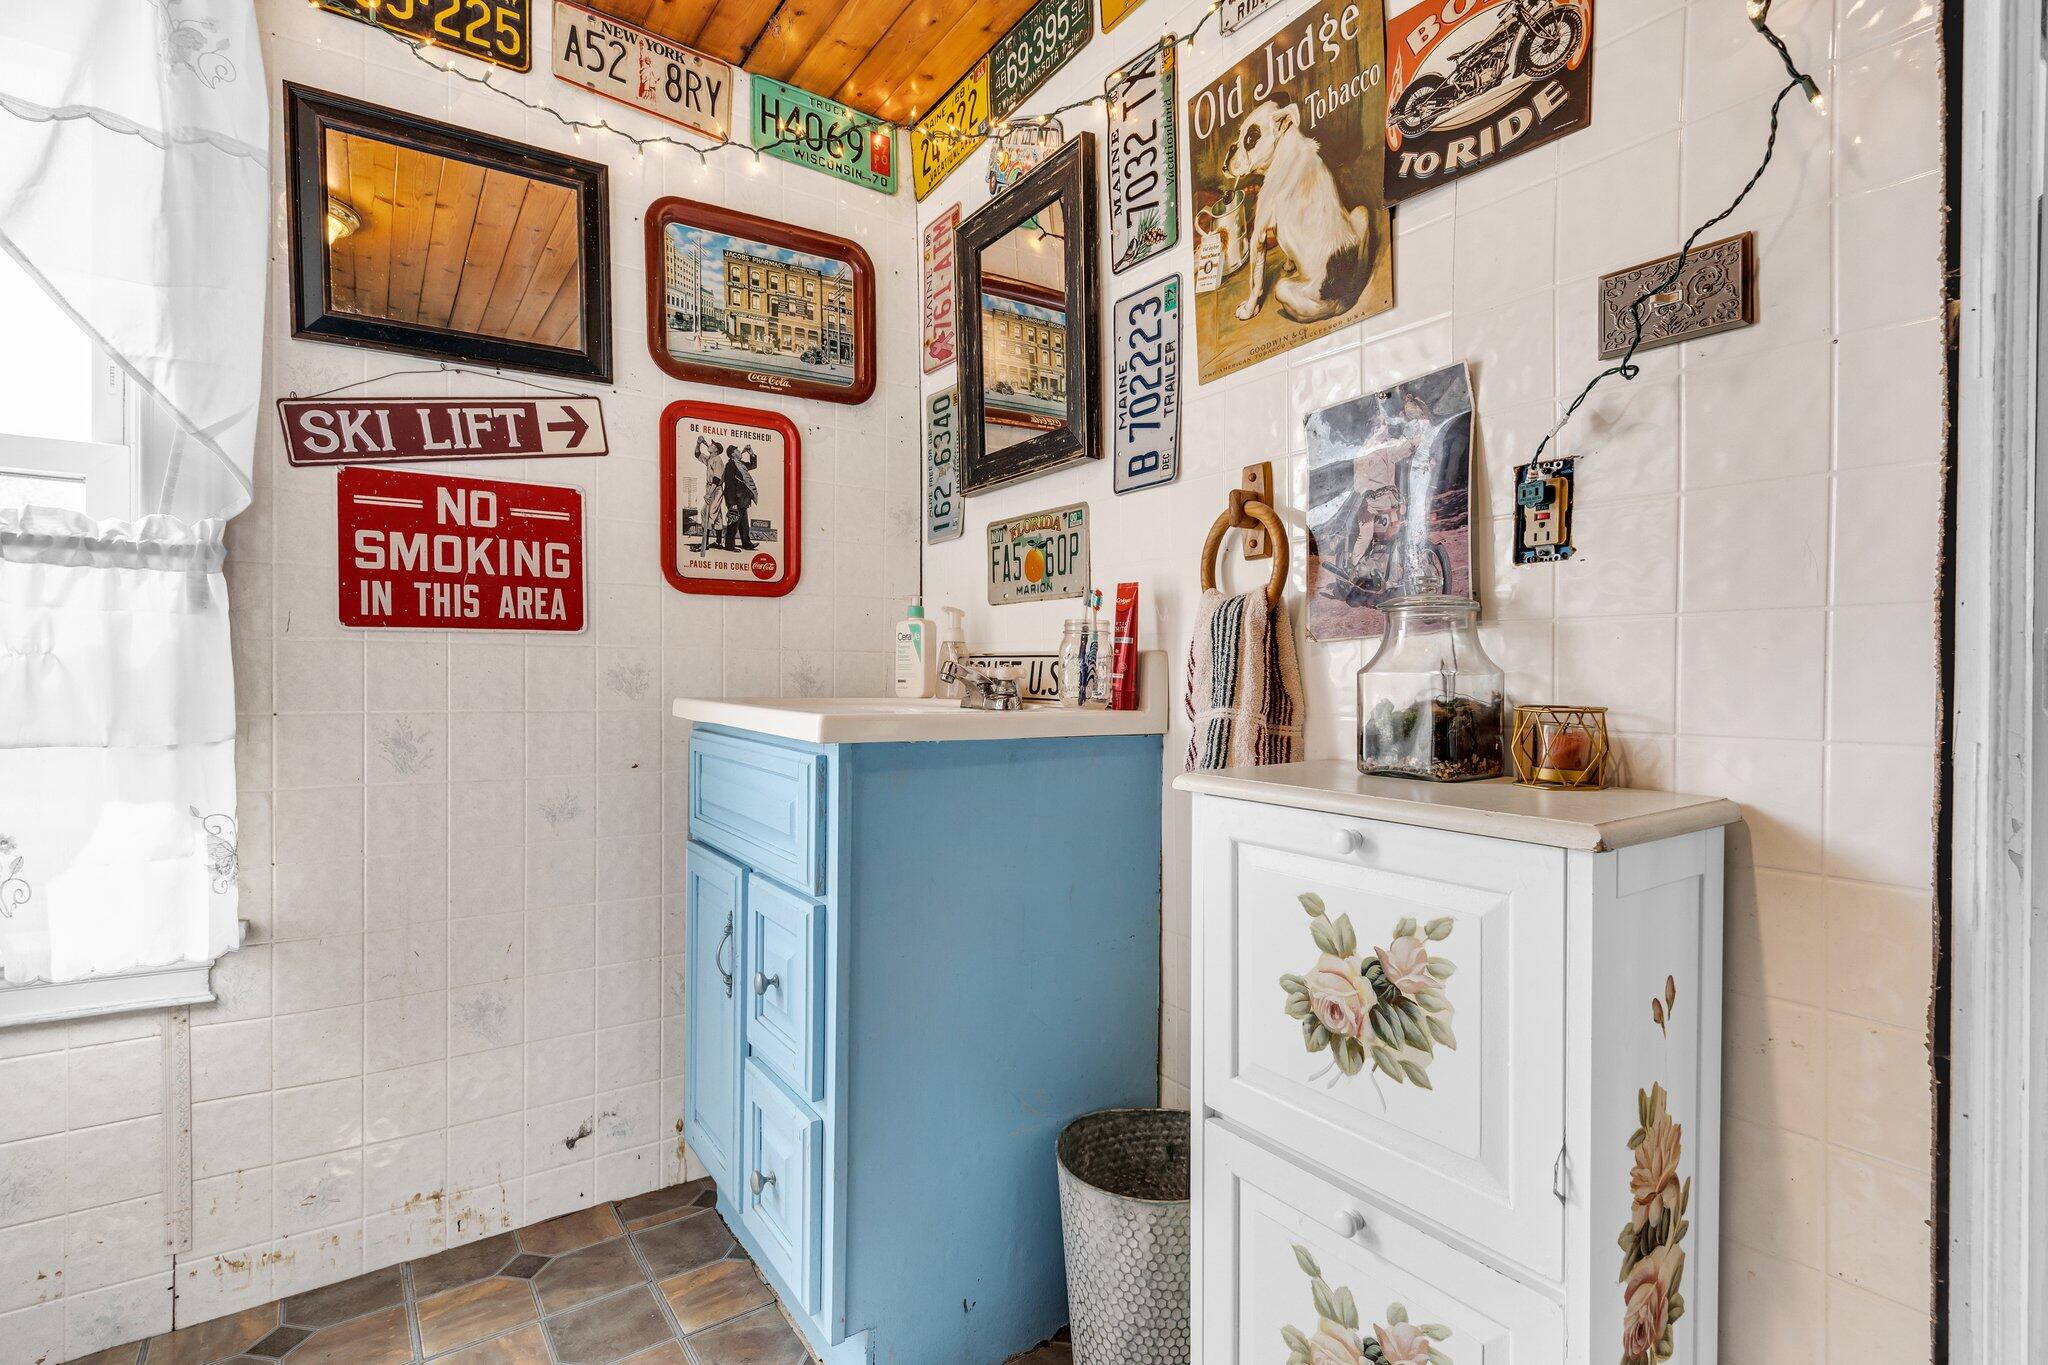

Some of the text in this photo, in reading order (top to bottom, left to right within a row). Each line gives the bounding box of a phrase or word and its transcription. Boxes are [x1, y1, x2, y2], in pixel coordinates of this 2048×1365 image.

[601, 21, 687, 65] NEW YORK
[564, 24, 722, 118] A52 8RY
[1020, 50, 1060, 94] MINNESOTA
[1194, 4, 1360, 140] Old Judge
[1304, 63, 1381, 130] Tobacco
[761, 93, 864, 164] H4069
[1121, 57, 1159, 229] 7032 TX
[1166, 97, 1174, 187] Vacationland
[1399, 80, 1571, 178] TO RIDE
[1111, 128, 1121, 218] MAINE
[1250, 334, 1290, 357] GOODWIN
[1118, 360, 1128, 430] MAINE
[1128, 296, 1162, 477] B 702223
[1163, 338, 1176, 418] TRAILER
[299, 407, 526, 454] SKI LIFT
[690, 423, 772, 443] BE REALLY REFRESHED!
[933, 394, 951, 532] 162 6340
[1162, 453, 1170, 471] DEC
[436, 486, 498, 528] NO
[1009, 514, 1062, 542] FLORIDA
[354, 529, 571, 580] SMOKING
[715, 561, 728, 570] FOR
[731, 563, 750, 571] COKE!
[992, 542, 1022, 583] FA5
[360, 579, 567, 621] IN THIS AREA
[1016, 582, 1053, 595] MARION
